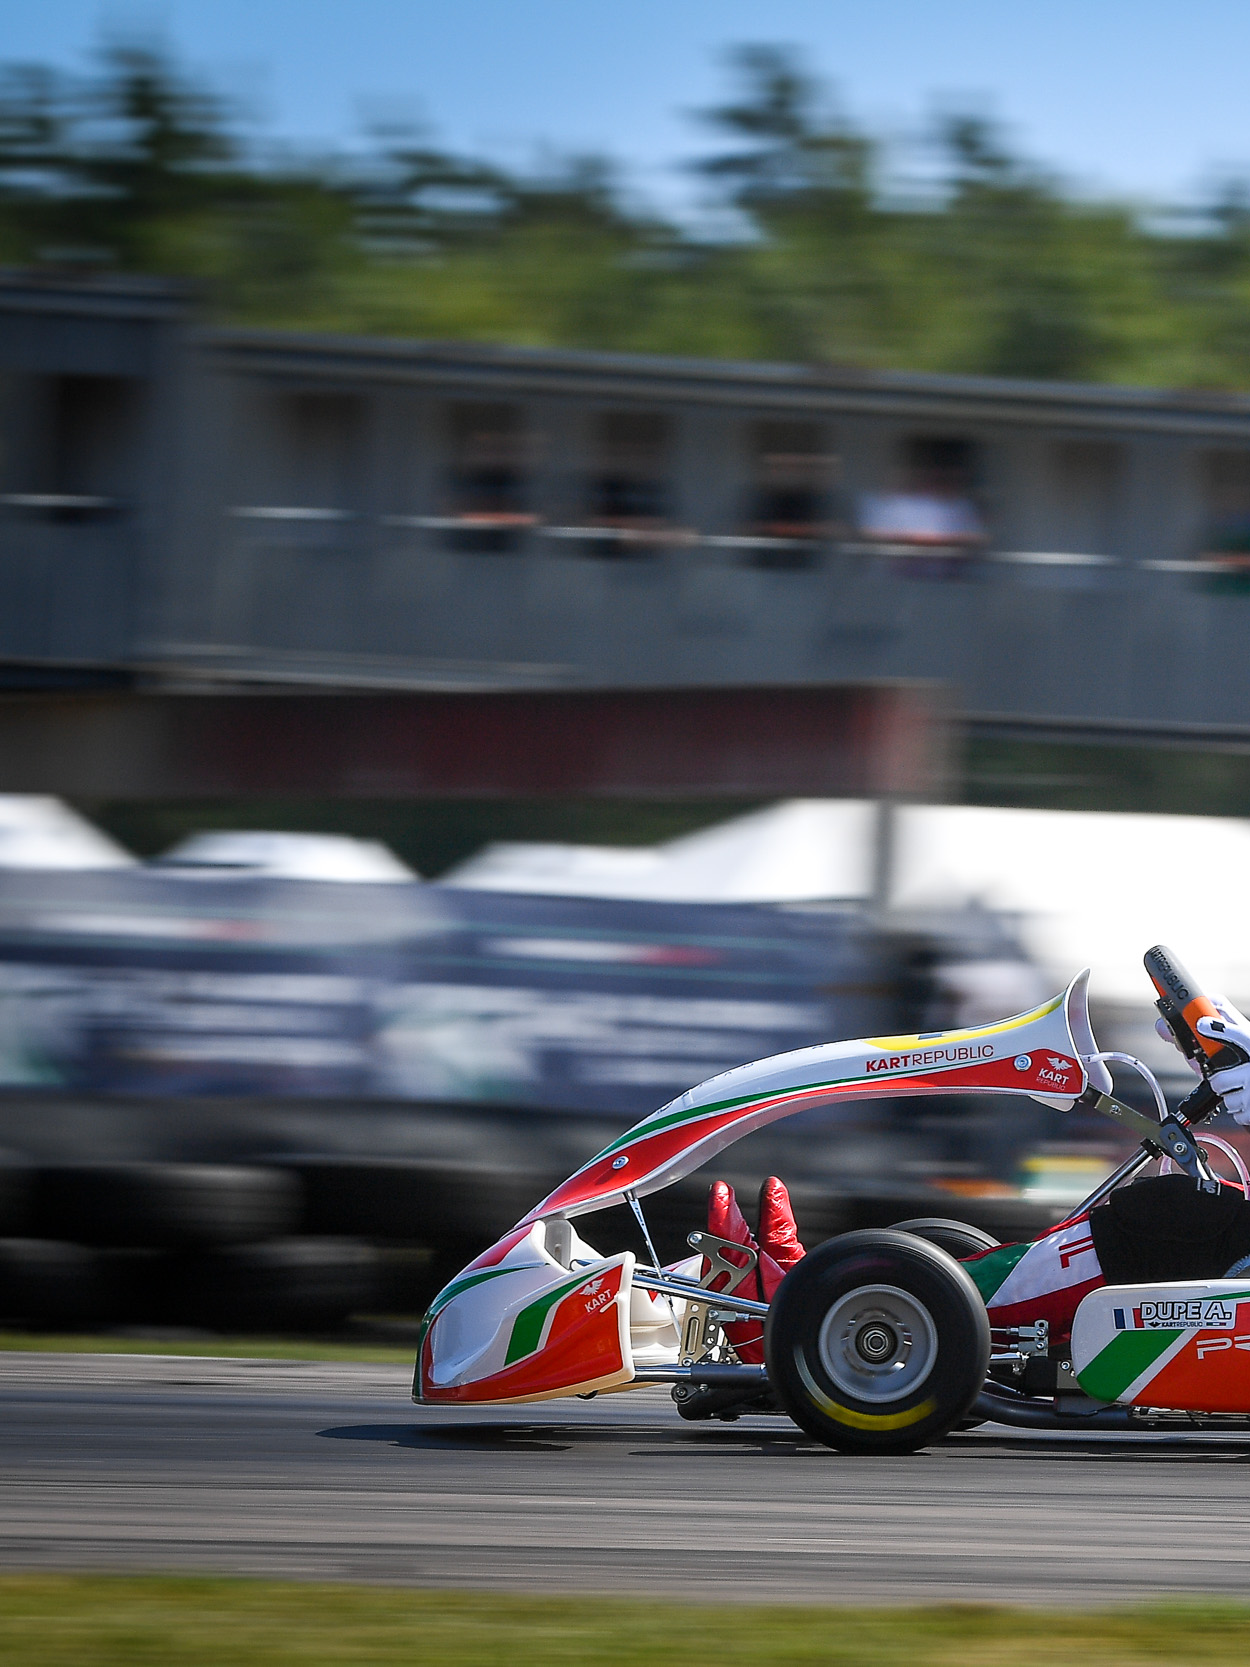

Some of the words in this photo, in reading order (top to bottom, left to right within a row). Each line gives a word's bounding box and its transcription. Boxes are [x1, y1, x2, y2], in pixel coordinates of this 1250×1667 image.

[866, 1045, 994, 1072] KARTREPUBLIC
[1038, 1068, 1069, 1085] KART
[584, 1289, 611, 1312] KART
[1140, 1301, 1202, 1320] DUPE
